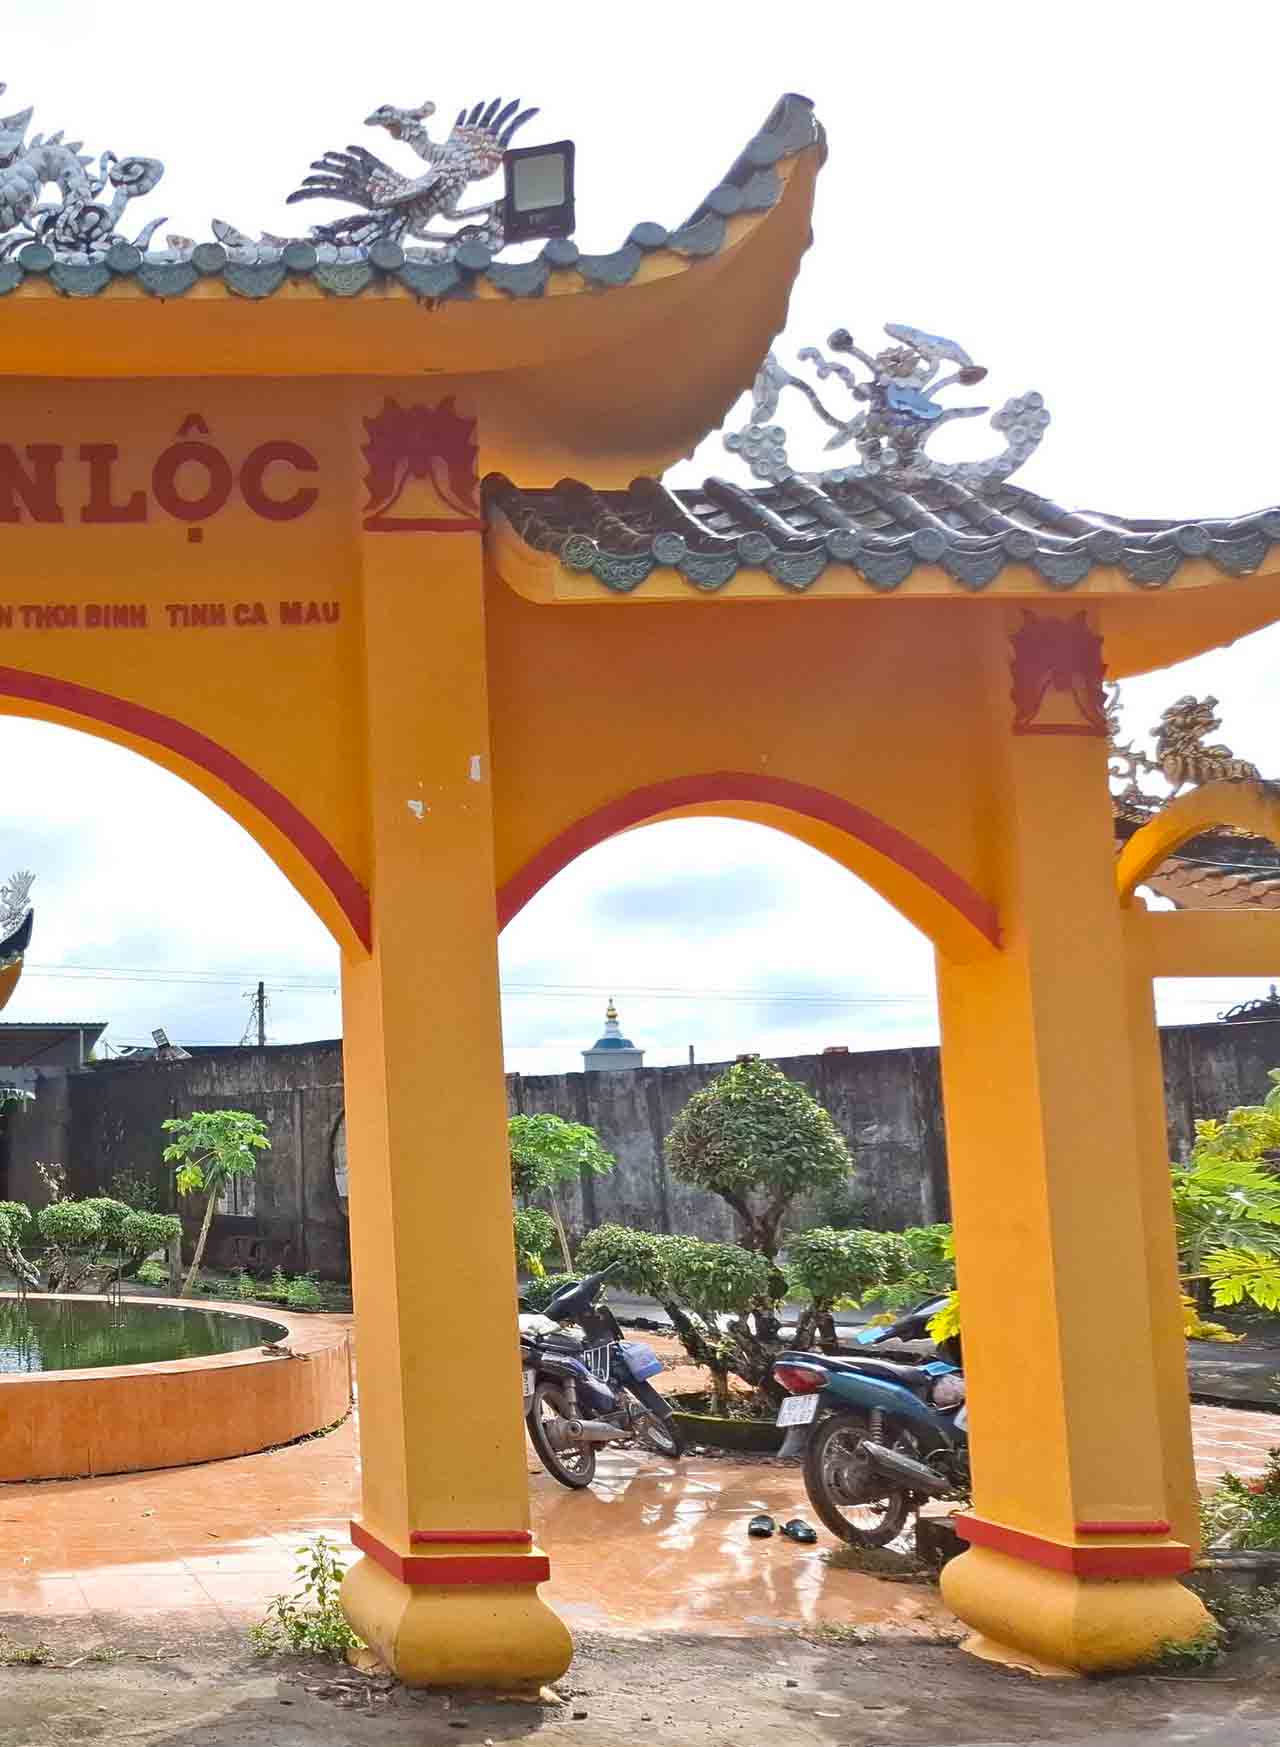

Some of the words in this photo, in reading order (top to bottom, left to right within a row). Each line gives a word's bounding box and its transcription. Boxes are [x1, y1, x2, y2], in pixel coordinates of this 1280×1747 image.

[80, 413, 320, 543] LỘC
[85, 604, 146, 629] BINH
[165, 604, 226, 627] TINH
[233, 602, 268, 627] CA
[280, 601, 340, 625] MAU
